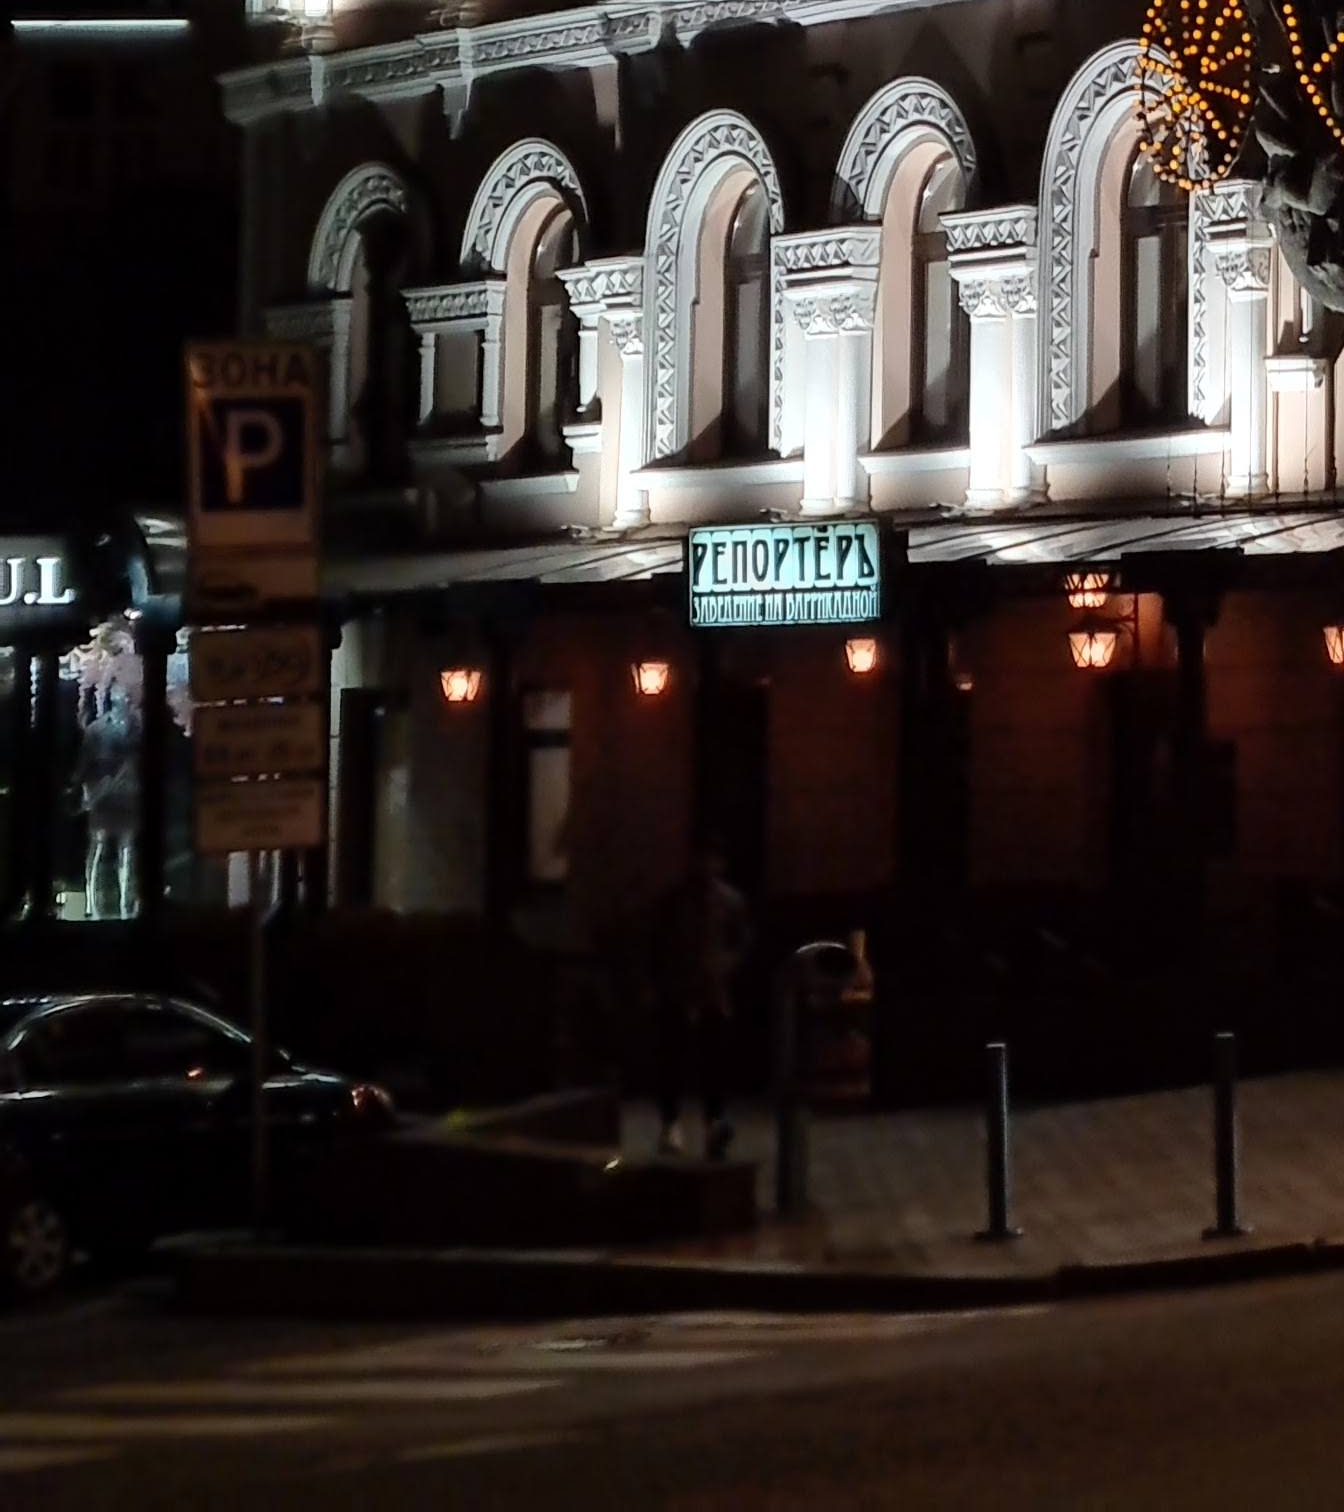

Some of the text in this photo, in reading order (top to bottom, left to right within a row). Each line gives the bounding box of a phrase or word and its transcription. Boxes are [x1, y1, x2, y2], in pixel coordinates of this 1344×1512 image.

[193, 352, 309, 387] ЗОНА
[225, 408, 284, 505] P
[692, 525, 875, 586] РЕПОРТЁРЪ
